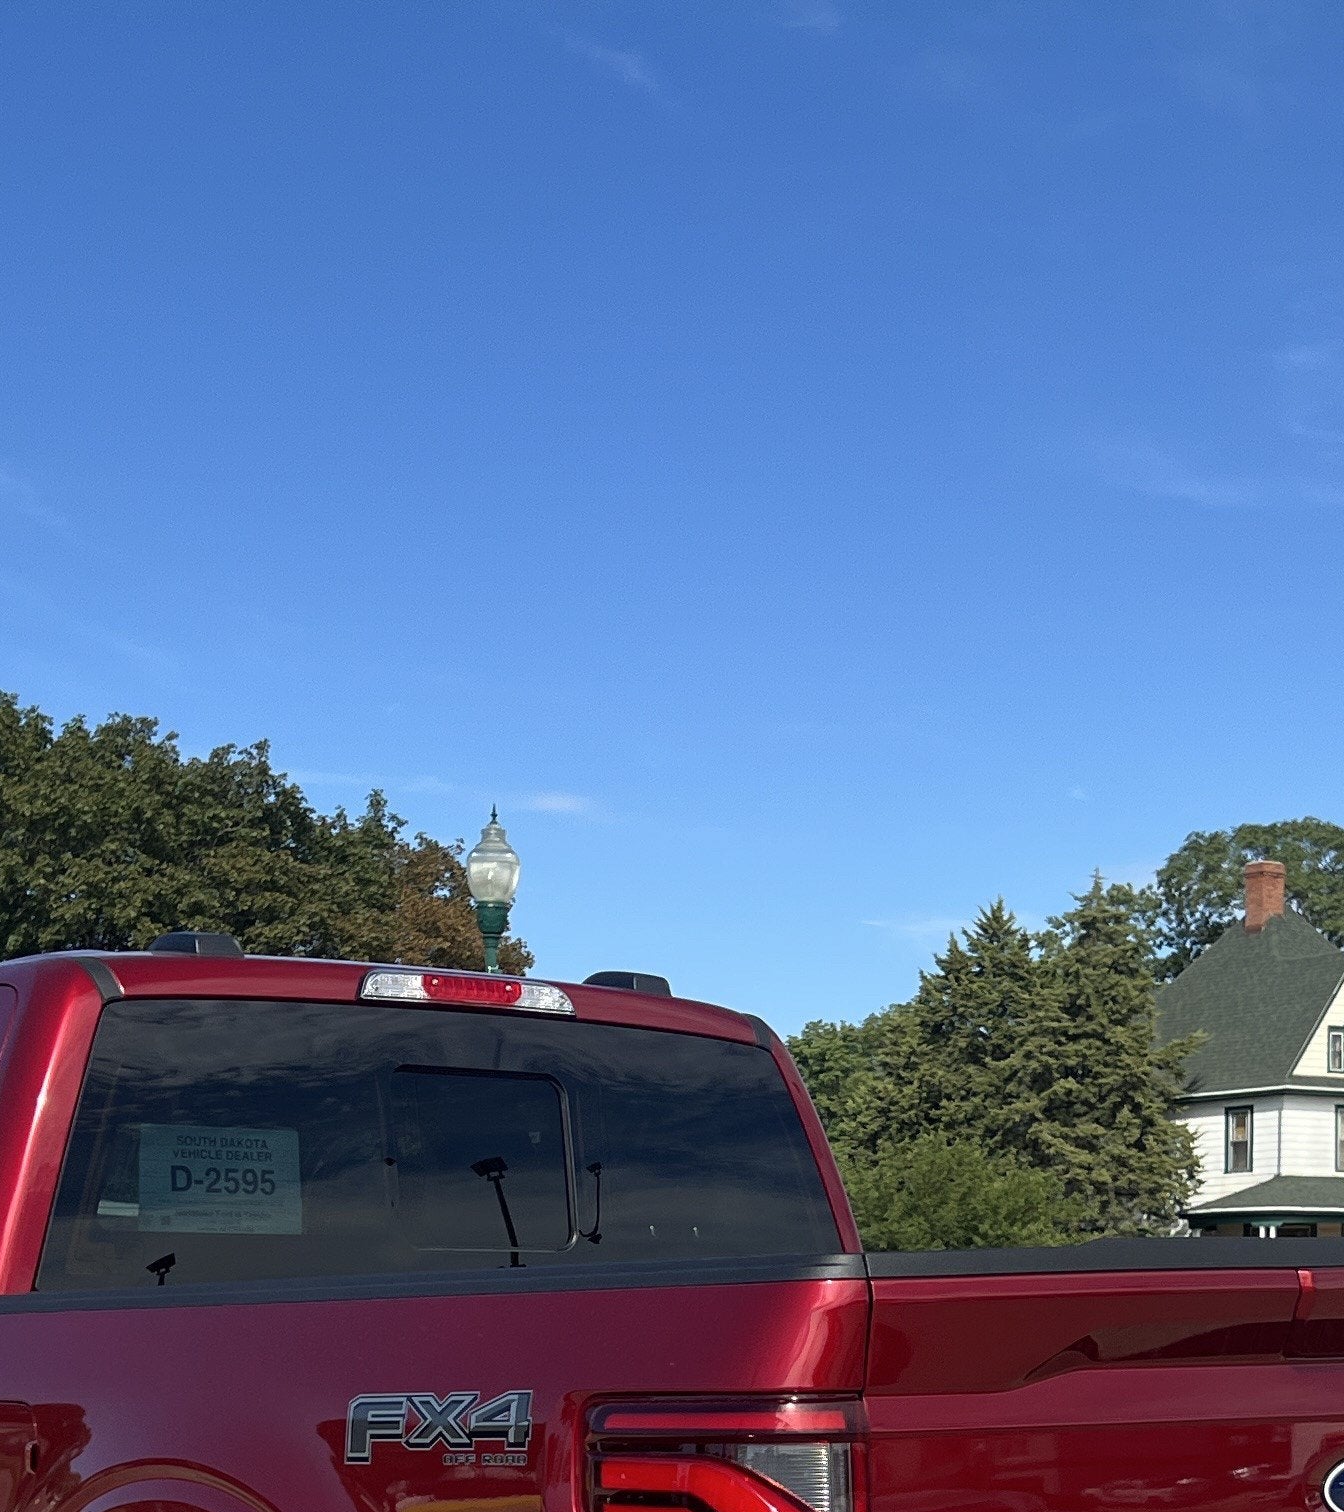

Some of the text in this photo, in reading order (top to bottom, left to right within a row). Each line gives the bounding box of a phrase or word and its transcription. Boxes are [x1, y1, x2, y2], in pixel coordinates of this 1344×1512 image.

[176, 1135, 269, 1150] SOUTH DAKOTA
[173, 1149, 272, 1161] VEHICLE DEALER
[170, 1165, 276, 1196] D-2595
[344, 1390, 533, 1464] FX4
[442, 1454, 528, 1466] OFF ROAD
